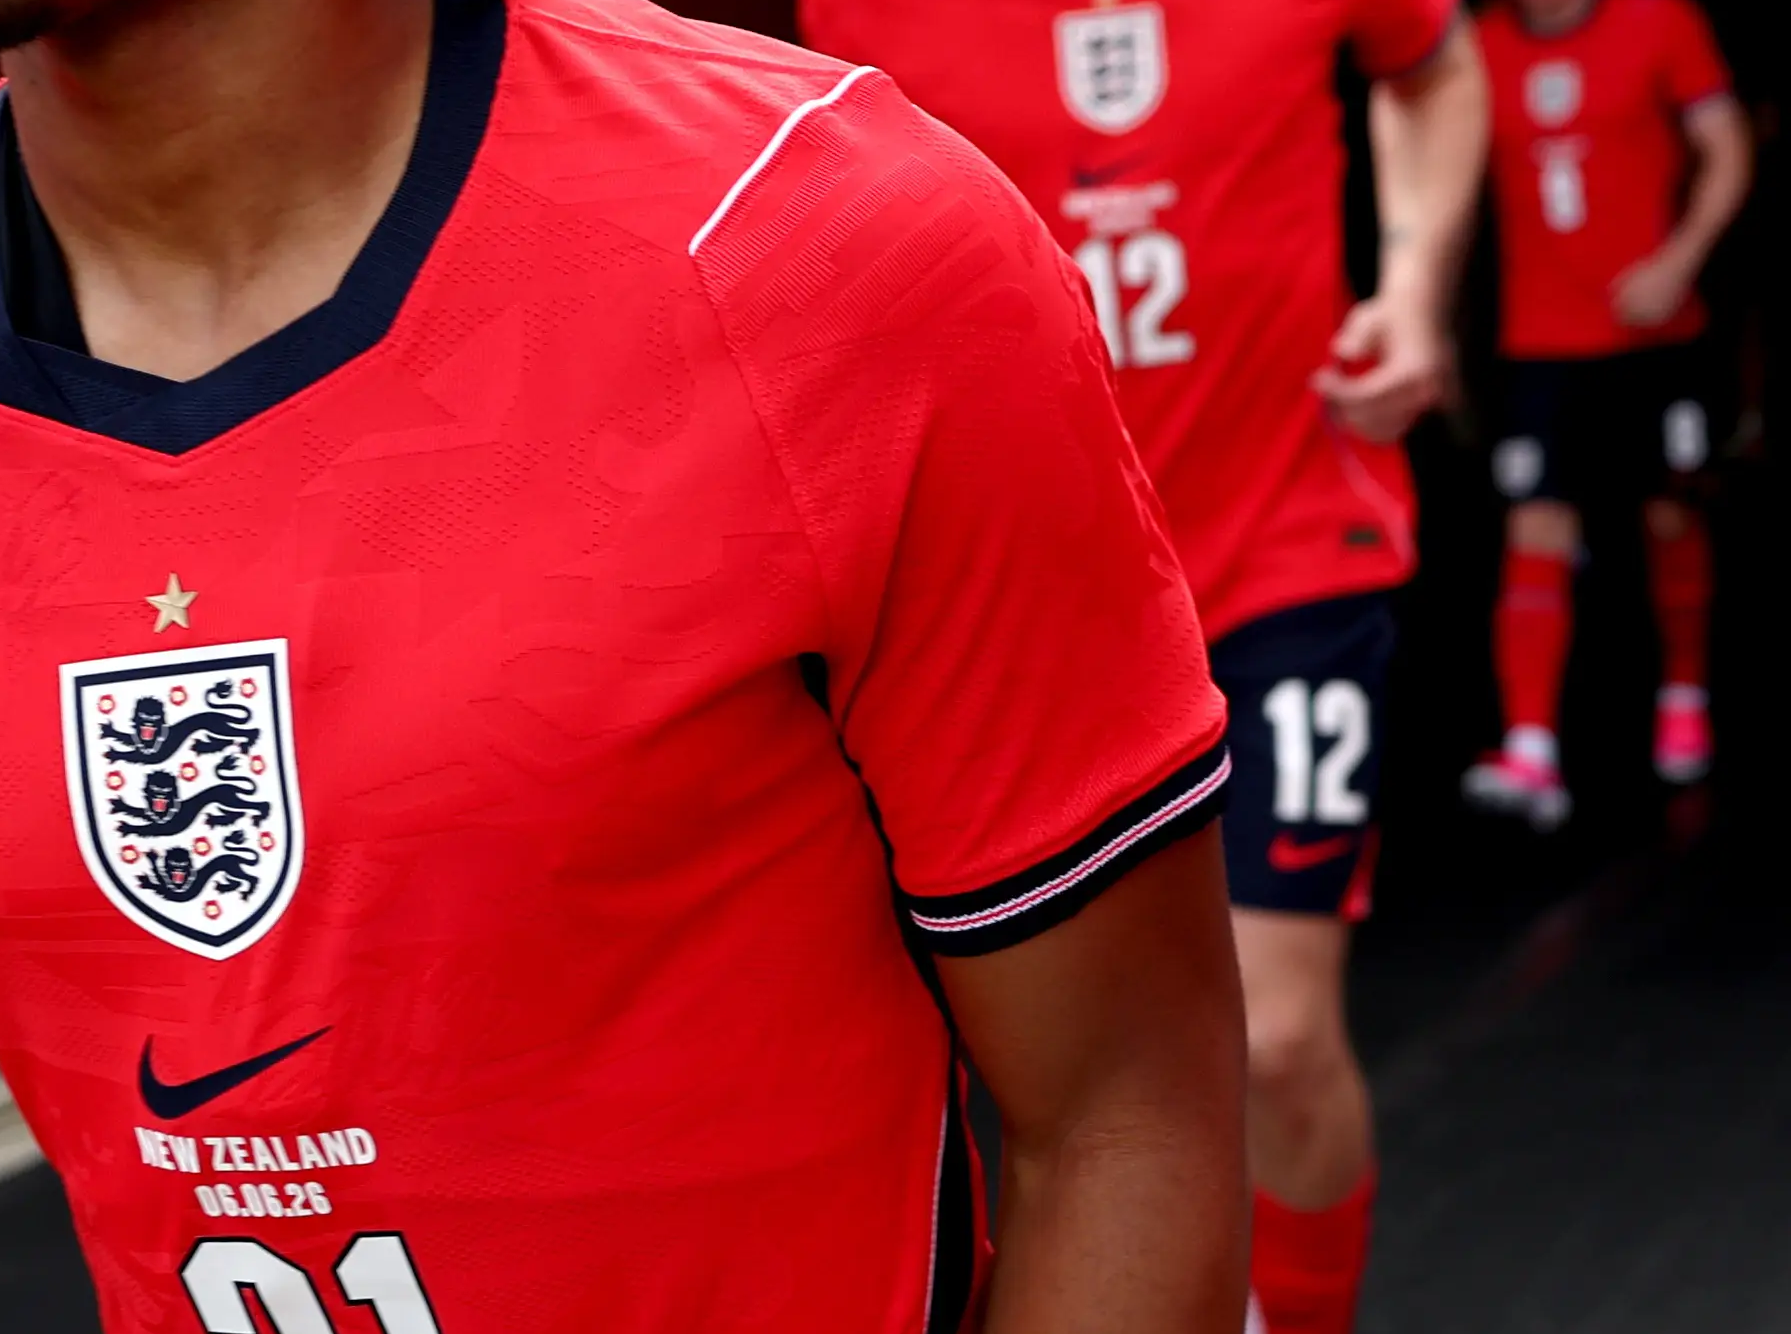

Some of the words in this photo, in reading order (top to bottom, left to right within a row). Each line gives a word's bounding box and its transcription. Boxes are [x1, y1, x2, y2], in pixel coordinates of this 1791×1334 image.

[1073, 229, 1194, 369] 12
[1262, 676, 1371, 825] 12
[134, 1126, 201, 1174] NEW
[202, 1127, 378, 1172] ZEALAND
[194, 1181, 333, 1218] 06.06.26
